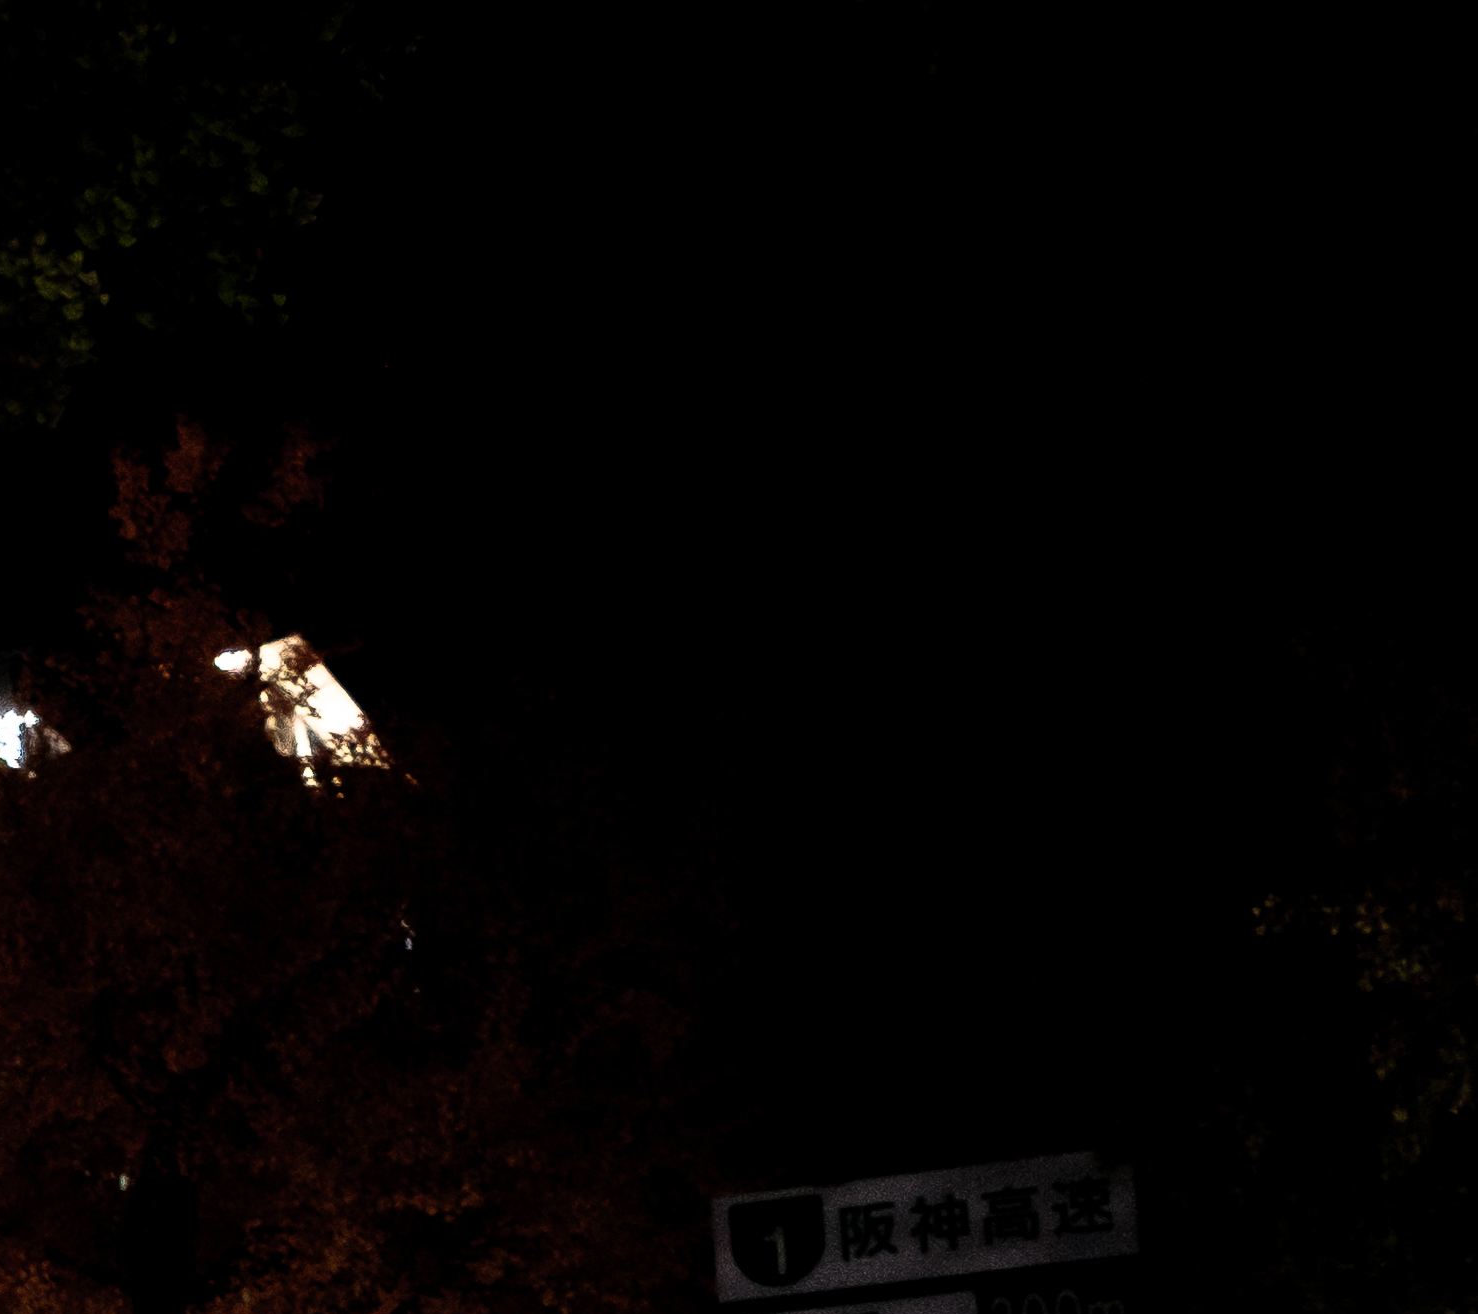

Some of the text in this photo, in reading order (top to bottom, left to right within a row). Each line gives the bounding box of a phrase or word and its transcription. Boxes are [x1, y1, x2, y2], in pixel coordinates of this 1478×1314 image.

[763, 1176, 1113, 1275] 1 阪神高速
